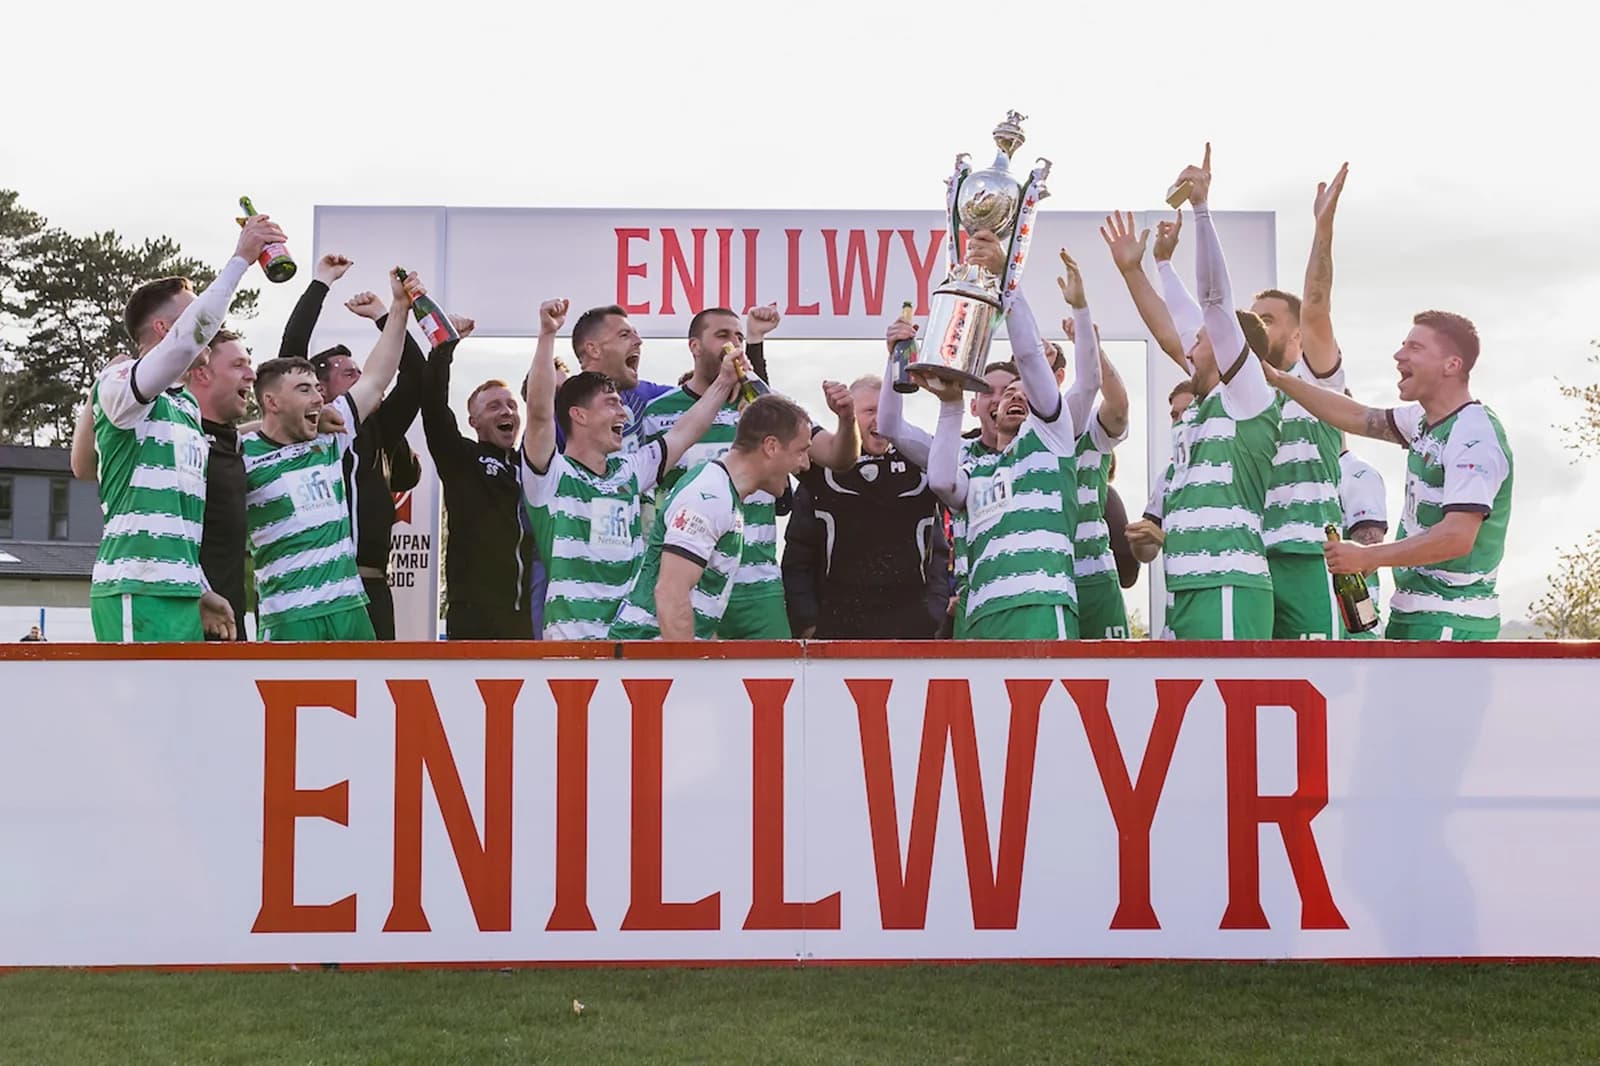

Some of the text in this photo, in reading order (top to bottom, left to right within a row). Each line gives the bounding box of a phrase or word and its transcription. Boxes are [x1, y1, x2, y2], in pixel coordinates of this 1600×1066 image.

[614, 228, 970, 316] ENILLWY
[391, 534, 430, 550] WPAN
[251, 678, 1350, 933] ENILLWYR
